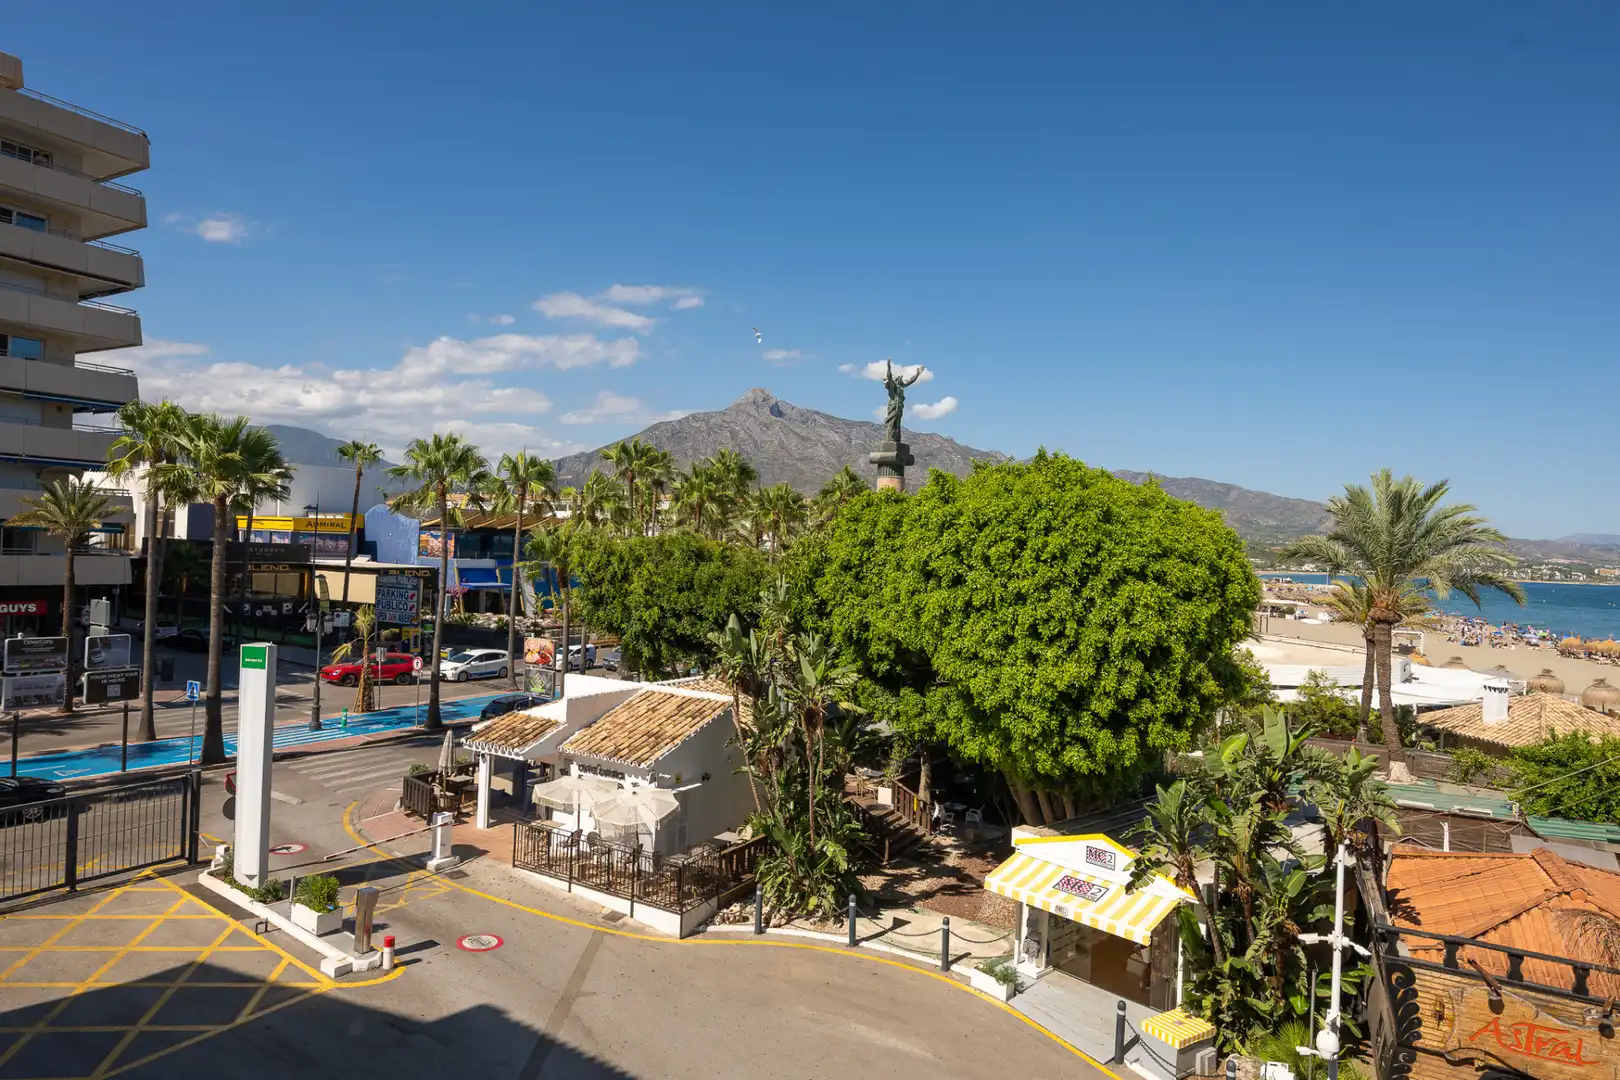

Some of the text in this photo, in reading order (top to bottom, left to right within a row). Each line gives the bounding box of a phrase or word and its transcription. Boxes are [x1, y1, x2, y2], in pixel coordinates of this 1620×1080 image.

[305, 520, 346, 529] ADMIRAL
[377, 588, 409, 600] PARKING
[0, 603, 37, 613] GUYS
[376, 600, 409, 611] PUBLICO
